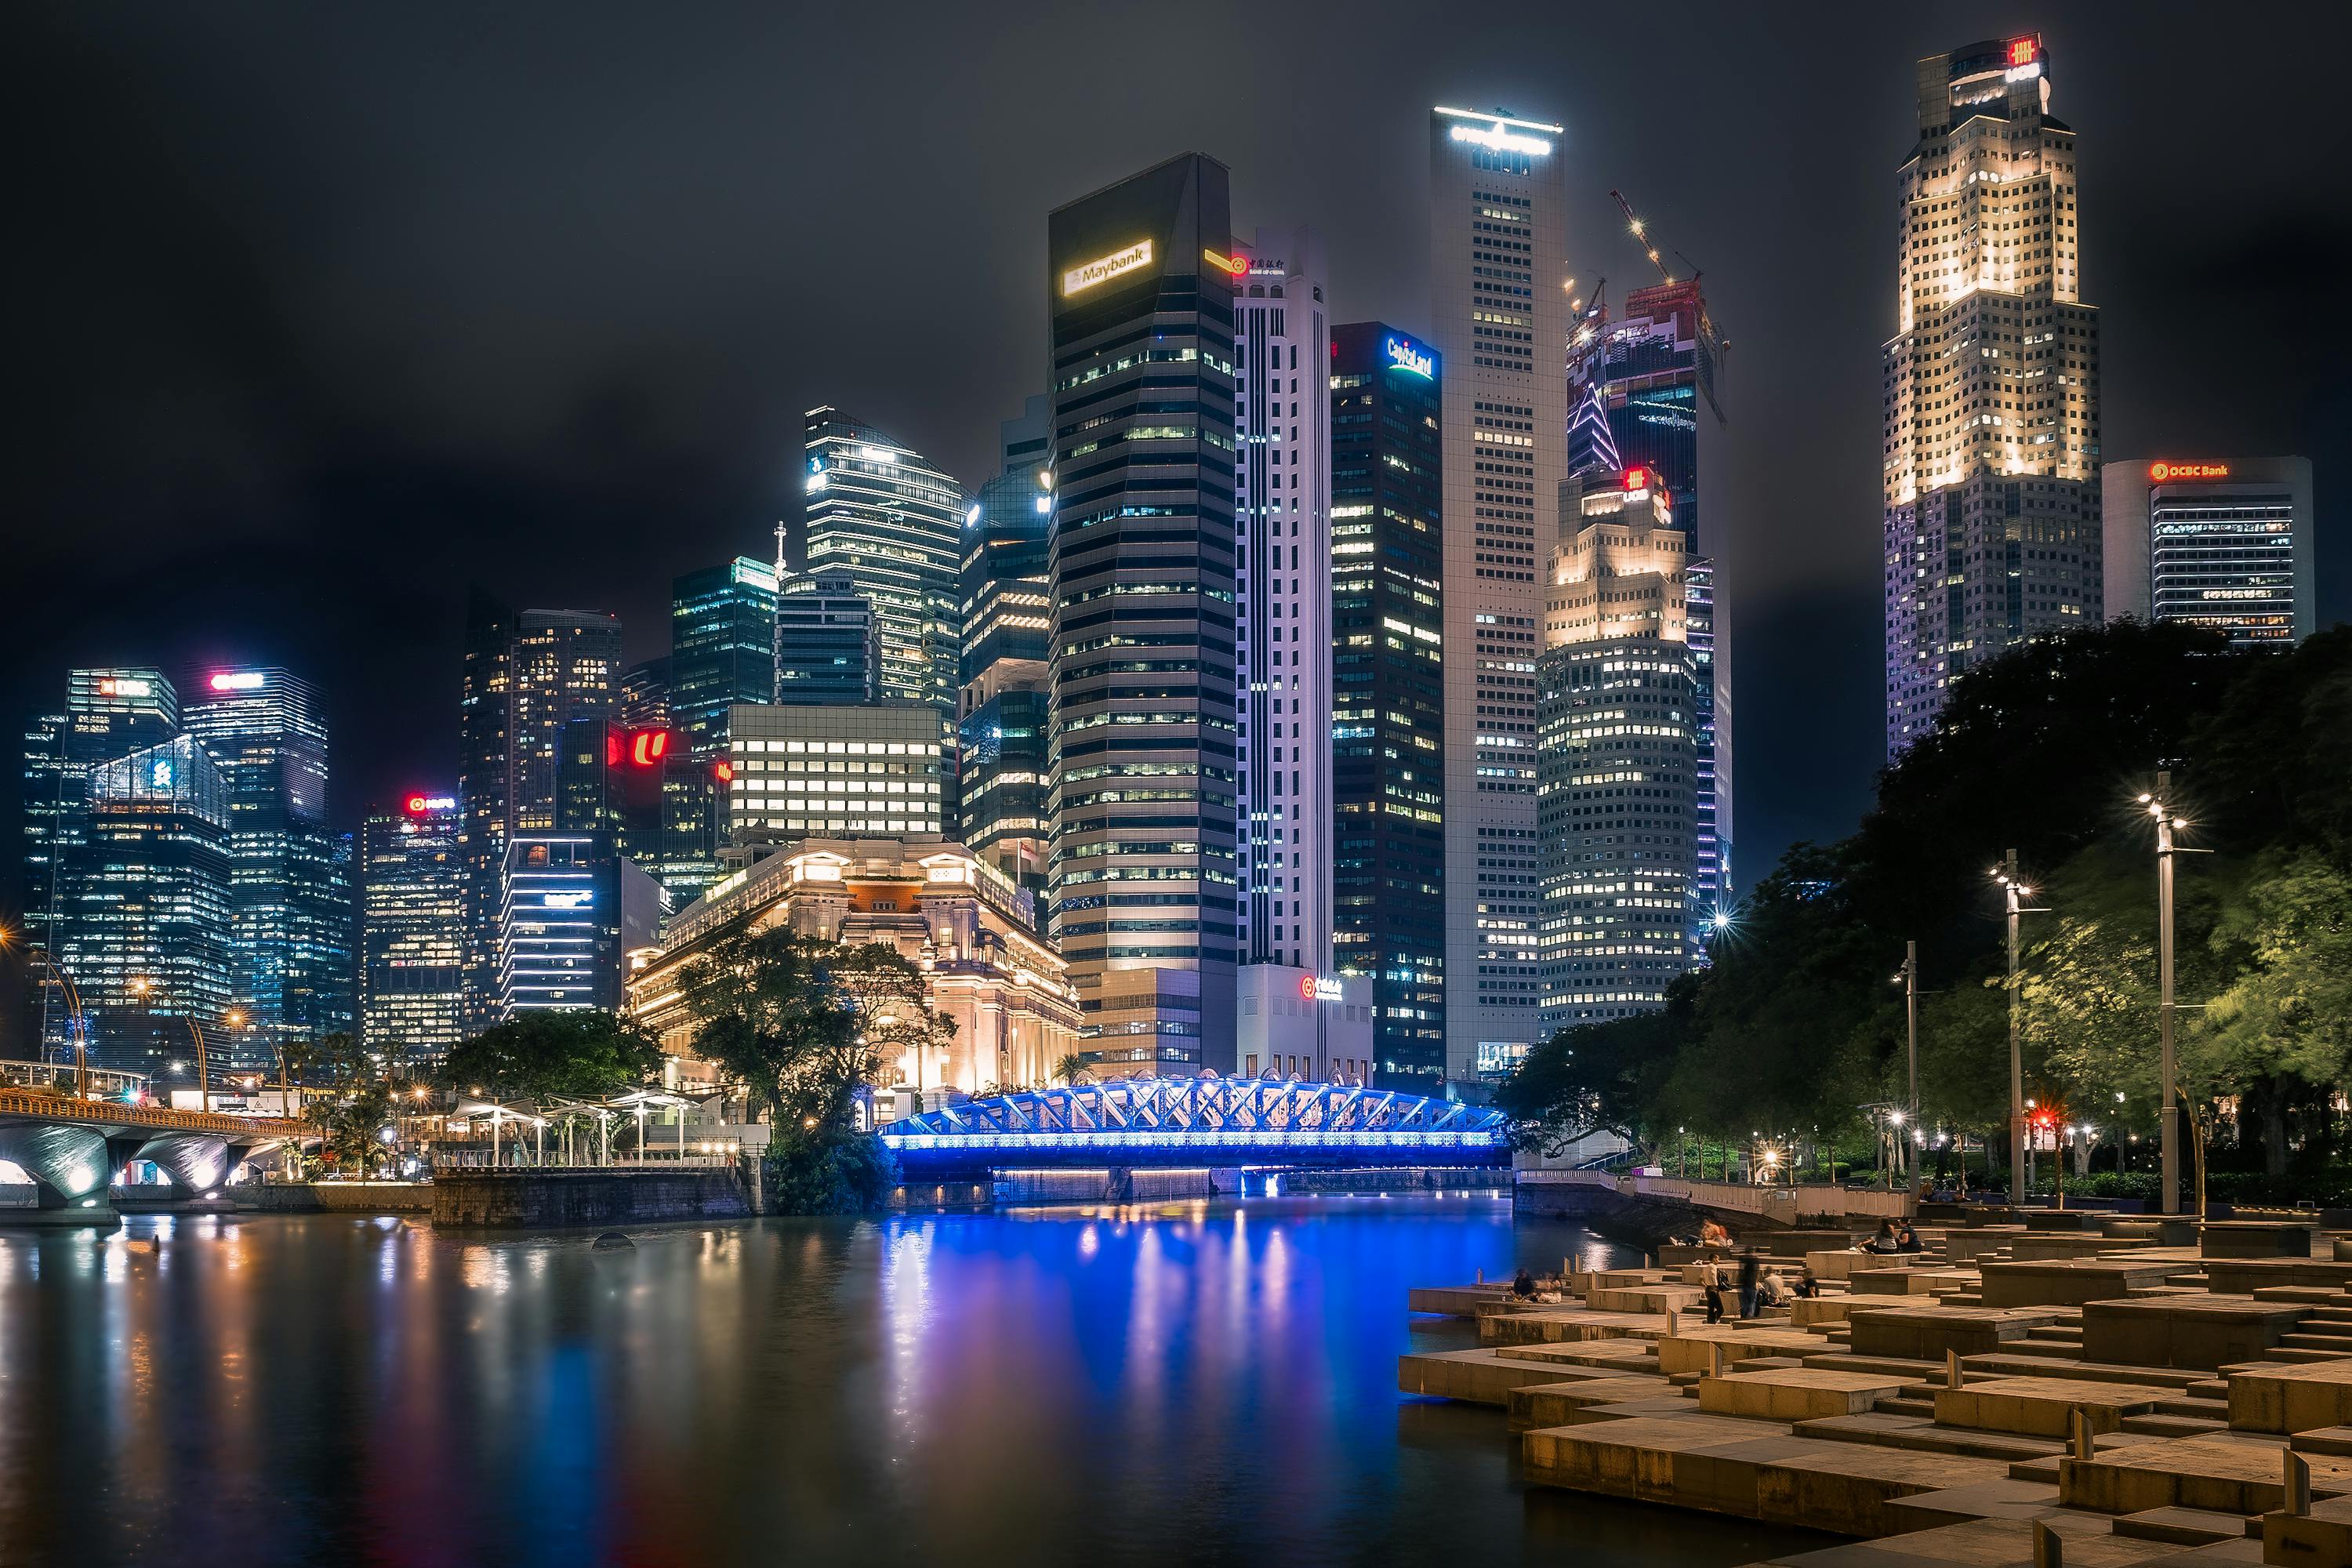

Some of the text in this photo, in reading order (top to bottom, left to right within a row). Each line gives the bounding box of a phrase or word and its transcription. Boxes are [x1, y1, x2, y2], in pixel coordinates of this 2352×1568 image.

[1082, 249, 1143, 283] Maybank
[2169, 465, 2228, 476] OCBC Bank
